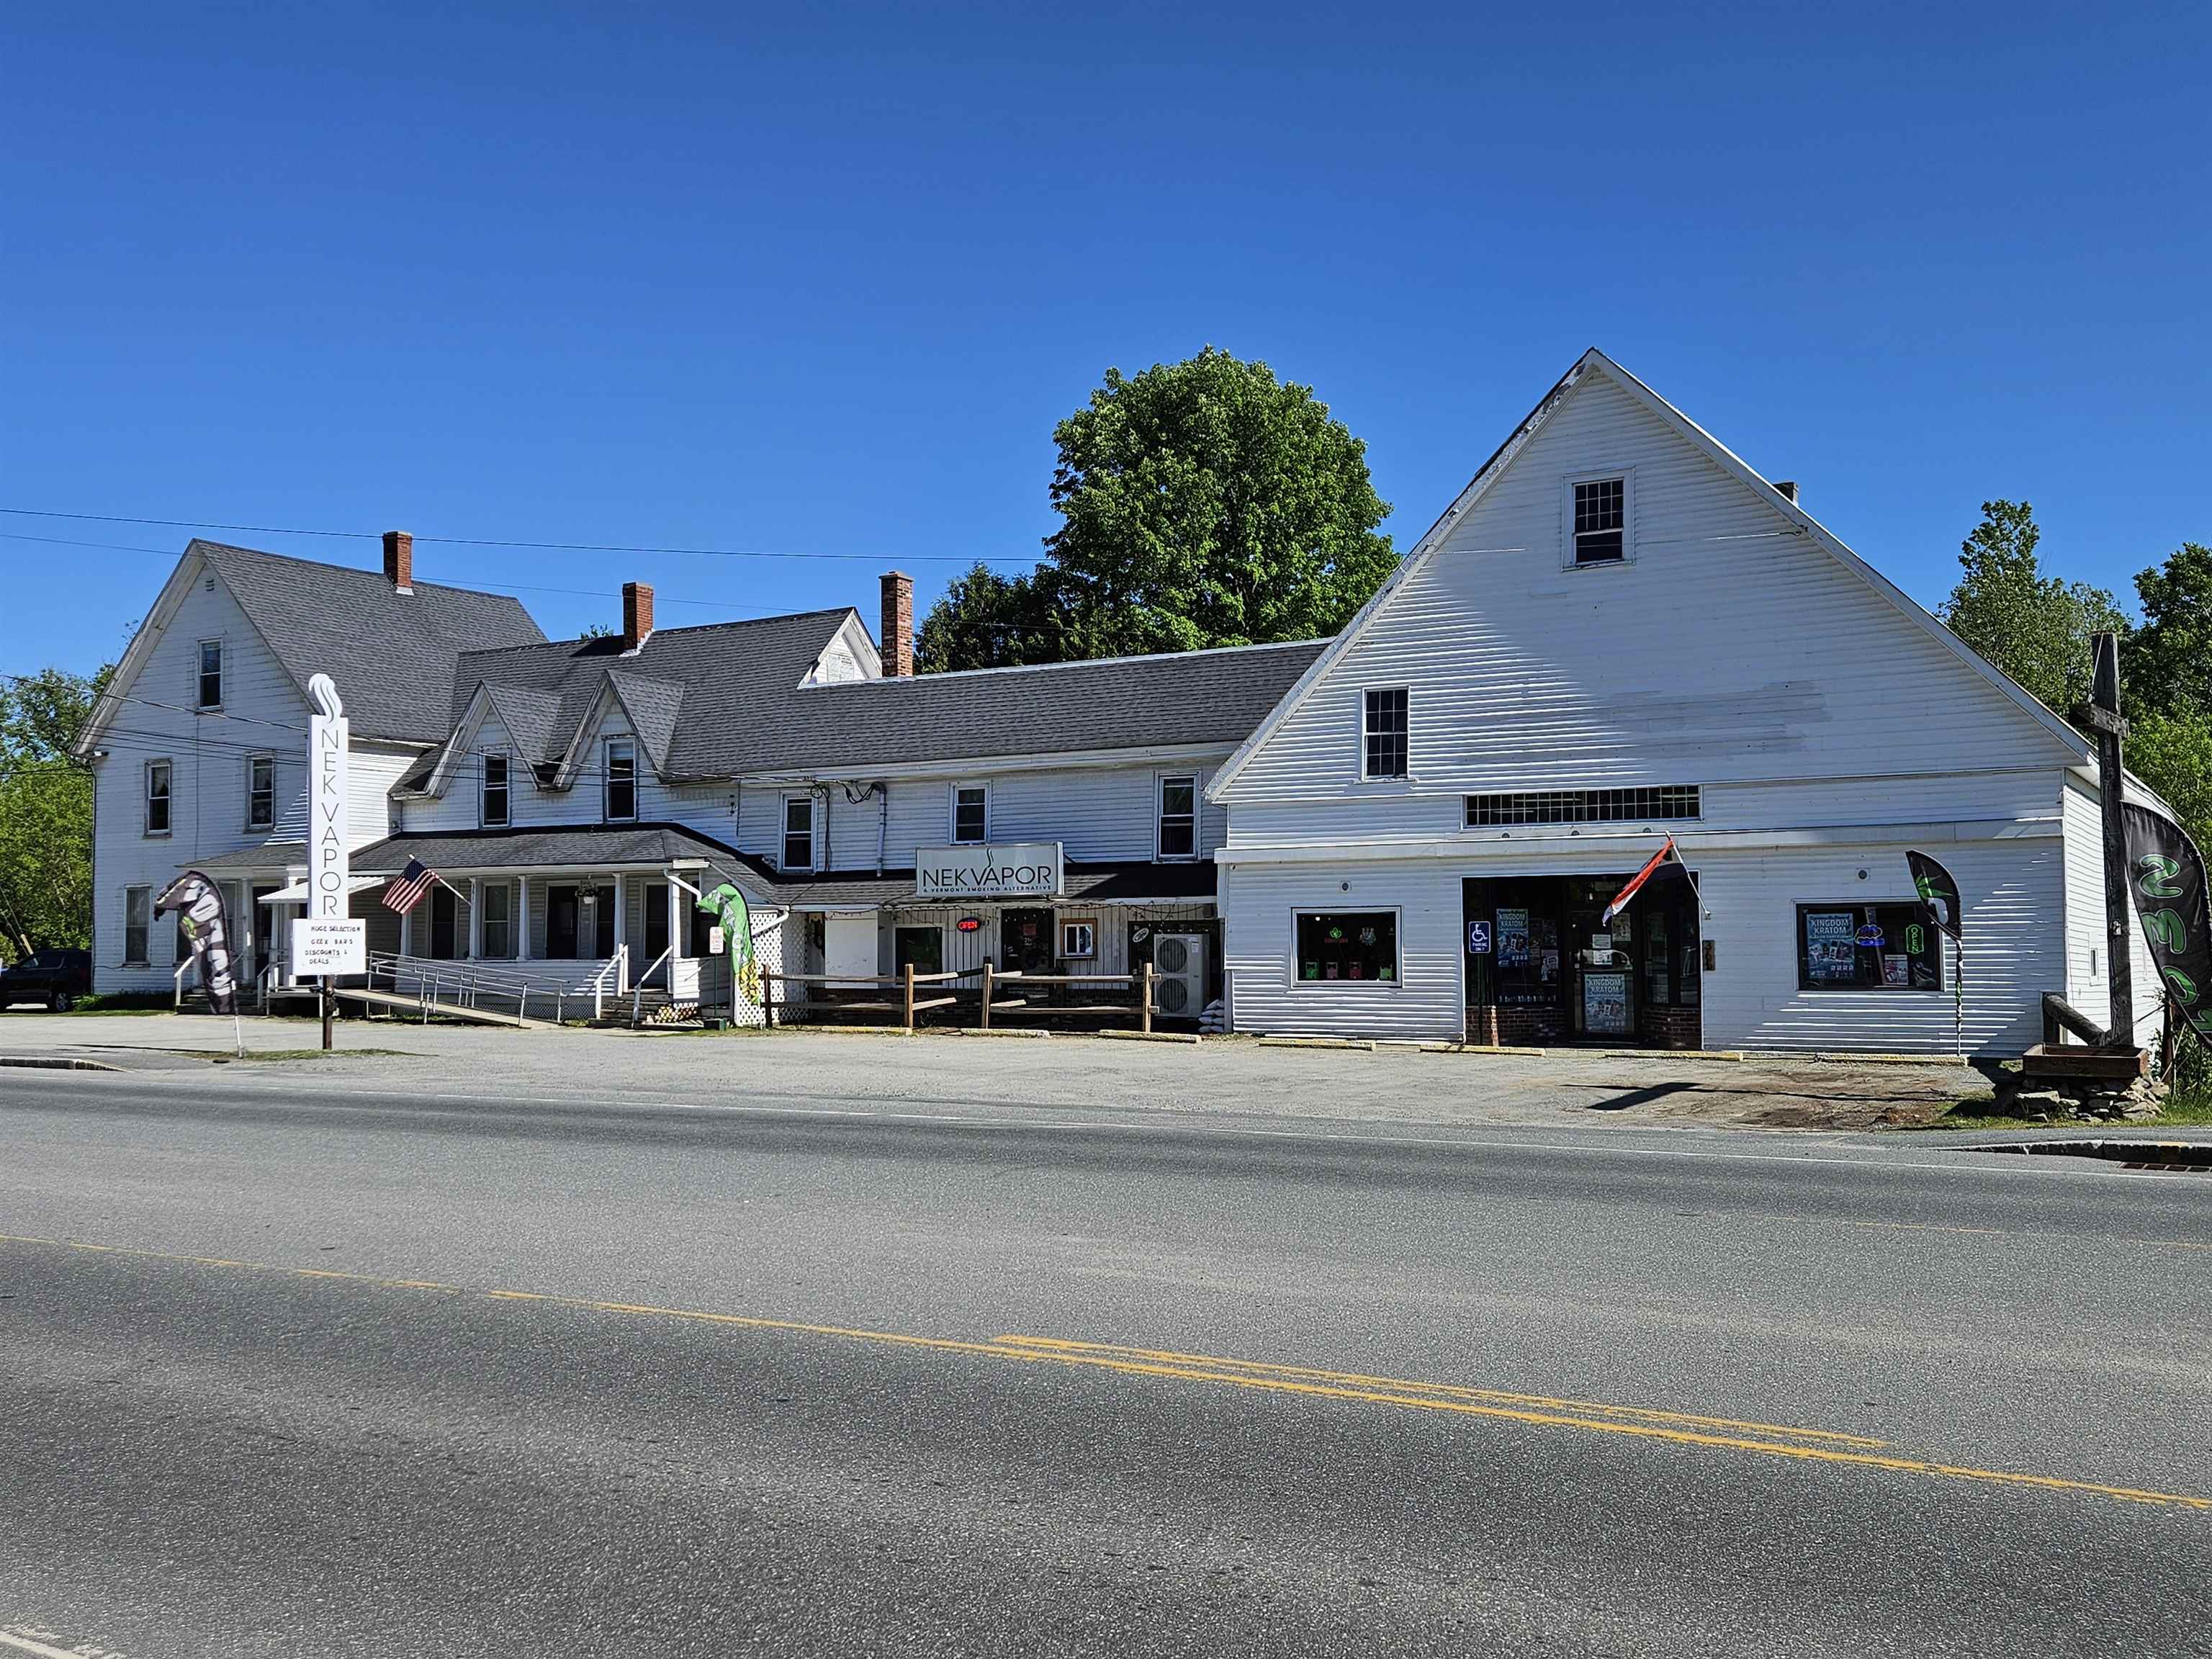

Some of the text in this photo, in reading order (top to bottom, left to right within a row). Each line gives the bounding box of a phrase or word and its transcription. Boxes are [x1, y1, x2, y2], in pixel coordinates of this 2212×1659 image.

[320, 729, 341, 915] NEK VAPOR
[923, 866, 1051, 886] NEK VAPOR
[1813, 926, 1847, 935] KRATOM
[1910, 927, 1919, 953] OPEN
